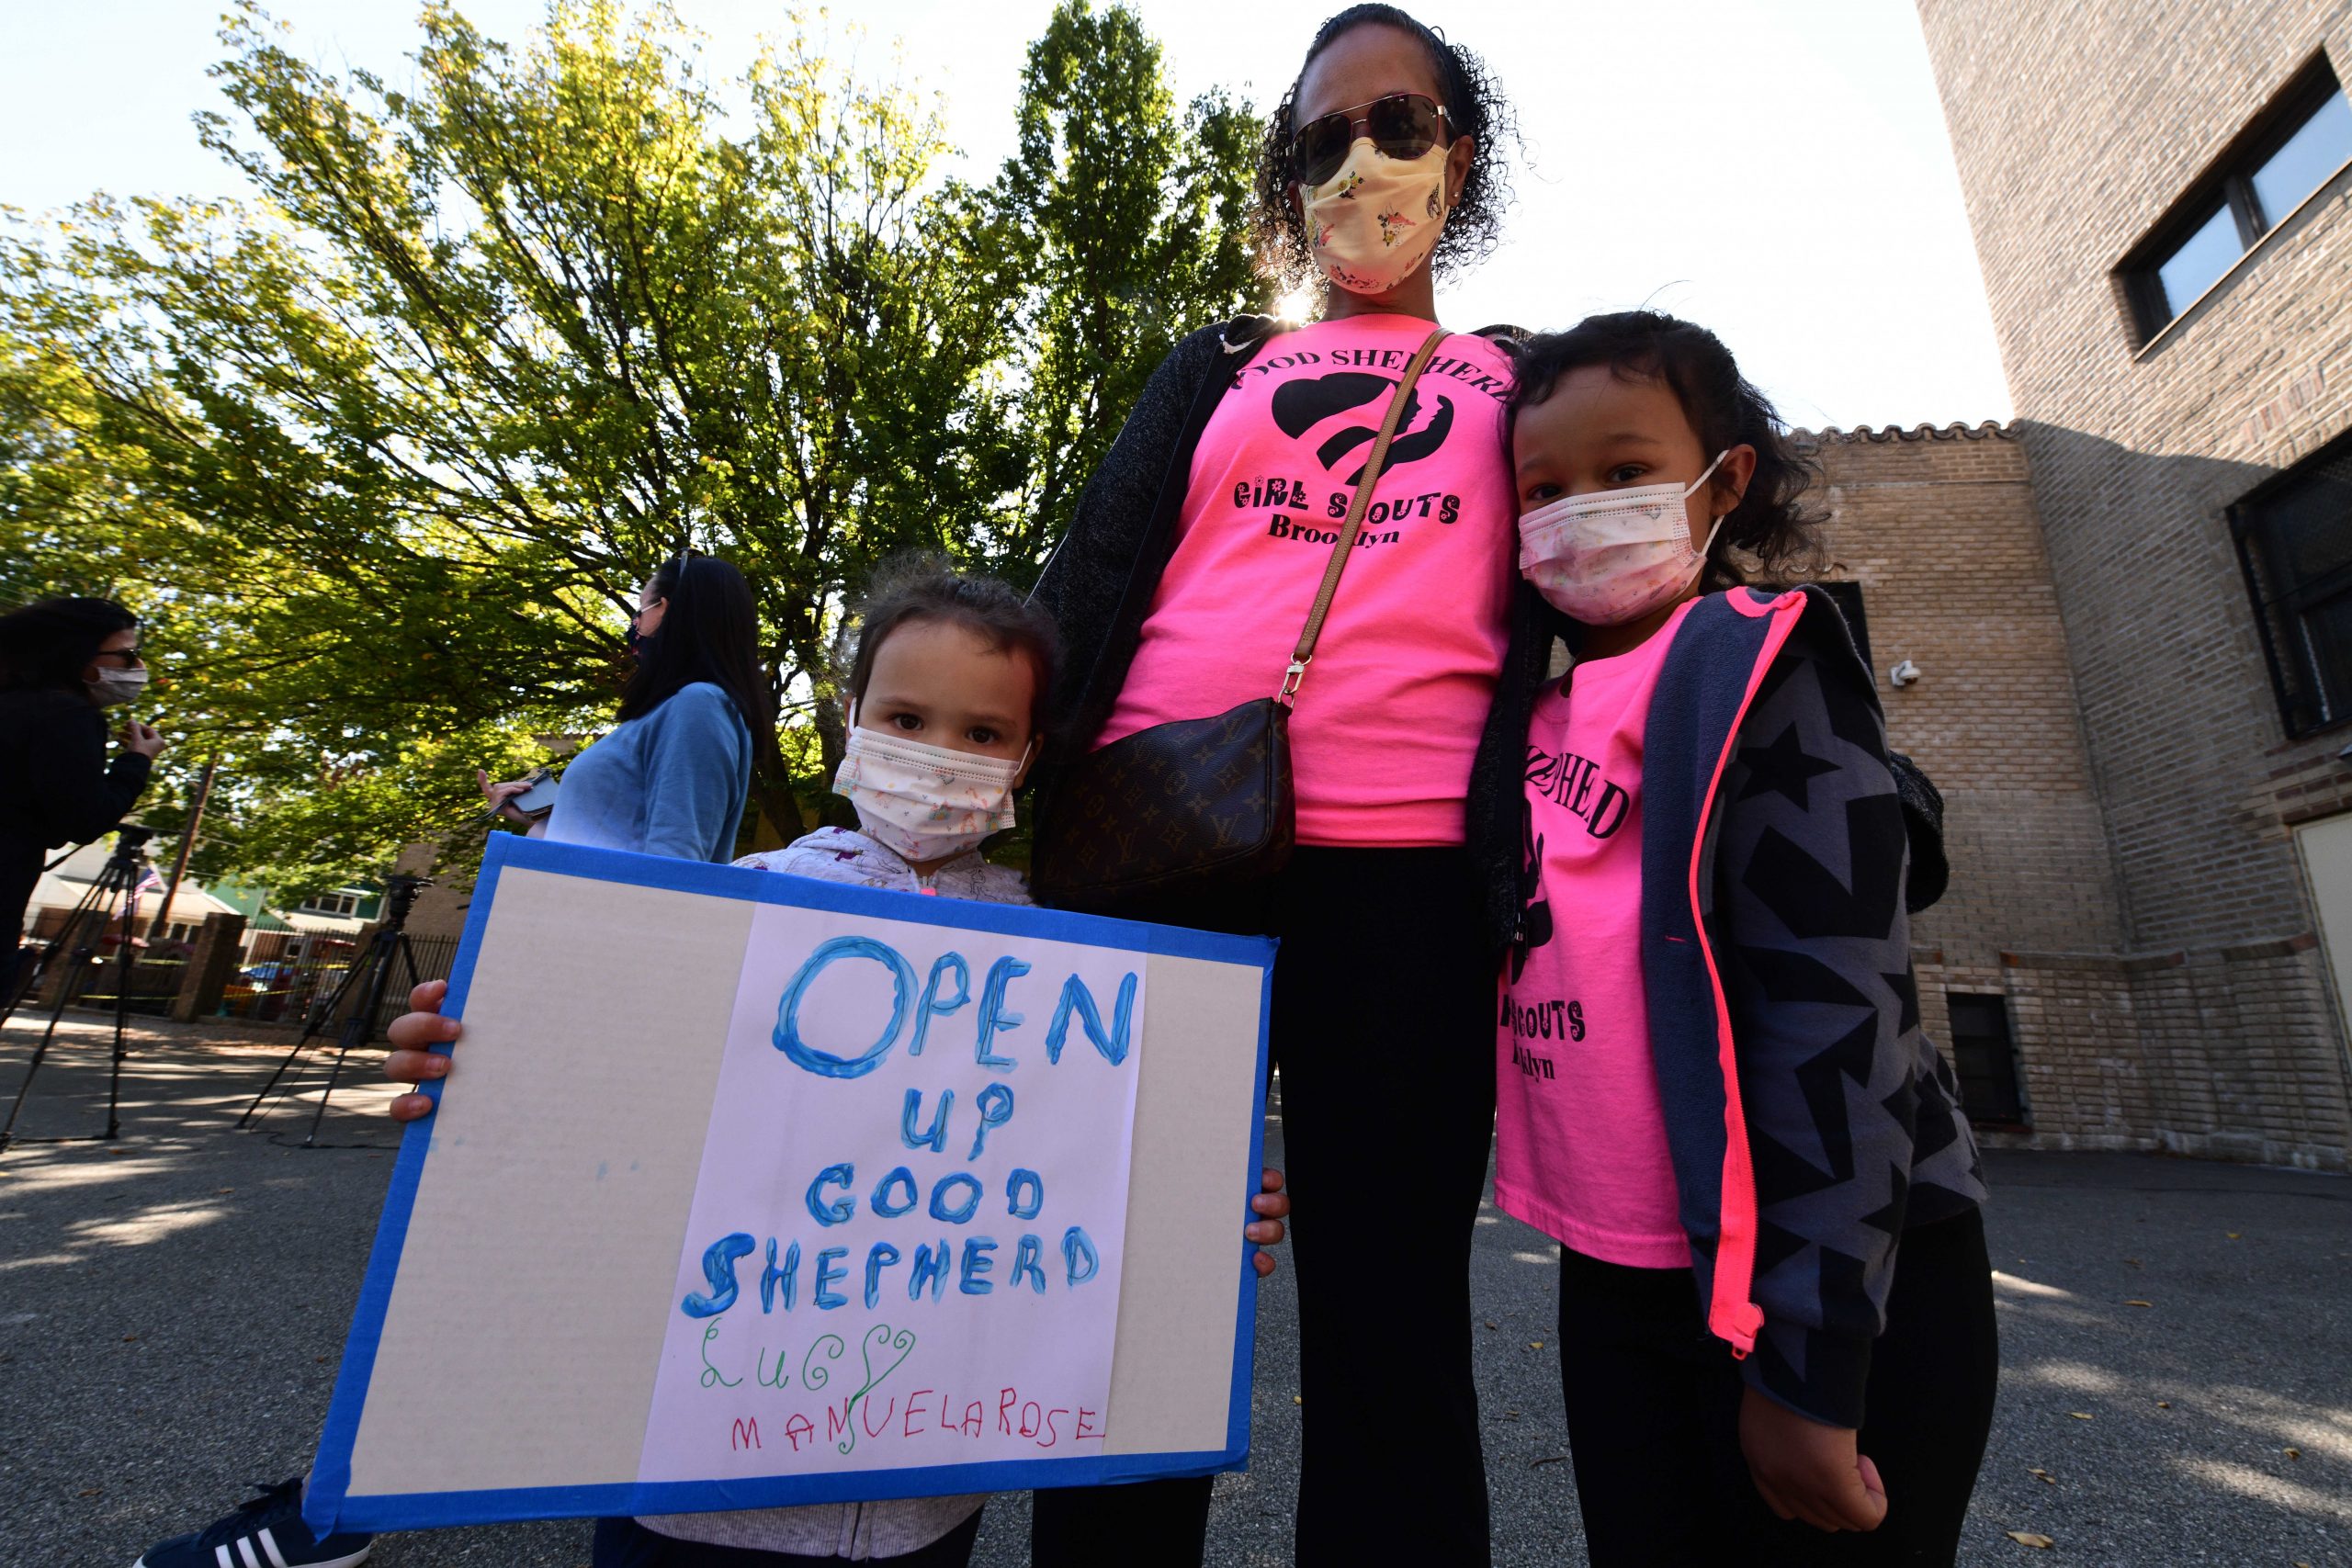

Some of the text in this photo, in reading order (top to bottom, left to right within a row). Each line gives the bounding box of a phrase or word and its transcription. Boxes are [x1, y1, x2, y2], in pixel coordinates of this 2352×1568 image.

[1331, 349, 1513, 403] SHEHER
[1233, 476, 1461, 525] GIRL SOUTS
[1267, 513, 1400, 549] Broolyn
[772, 935, 1137, 1079] OPEN
[900, 1082, 1014, 1161] UP
[806, 1162, 1045, 1227] GOOD
[681, 1226, 1099, 1319] SHEPHERD
